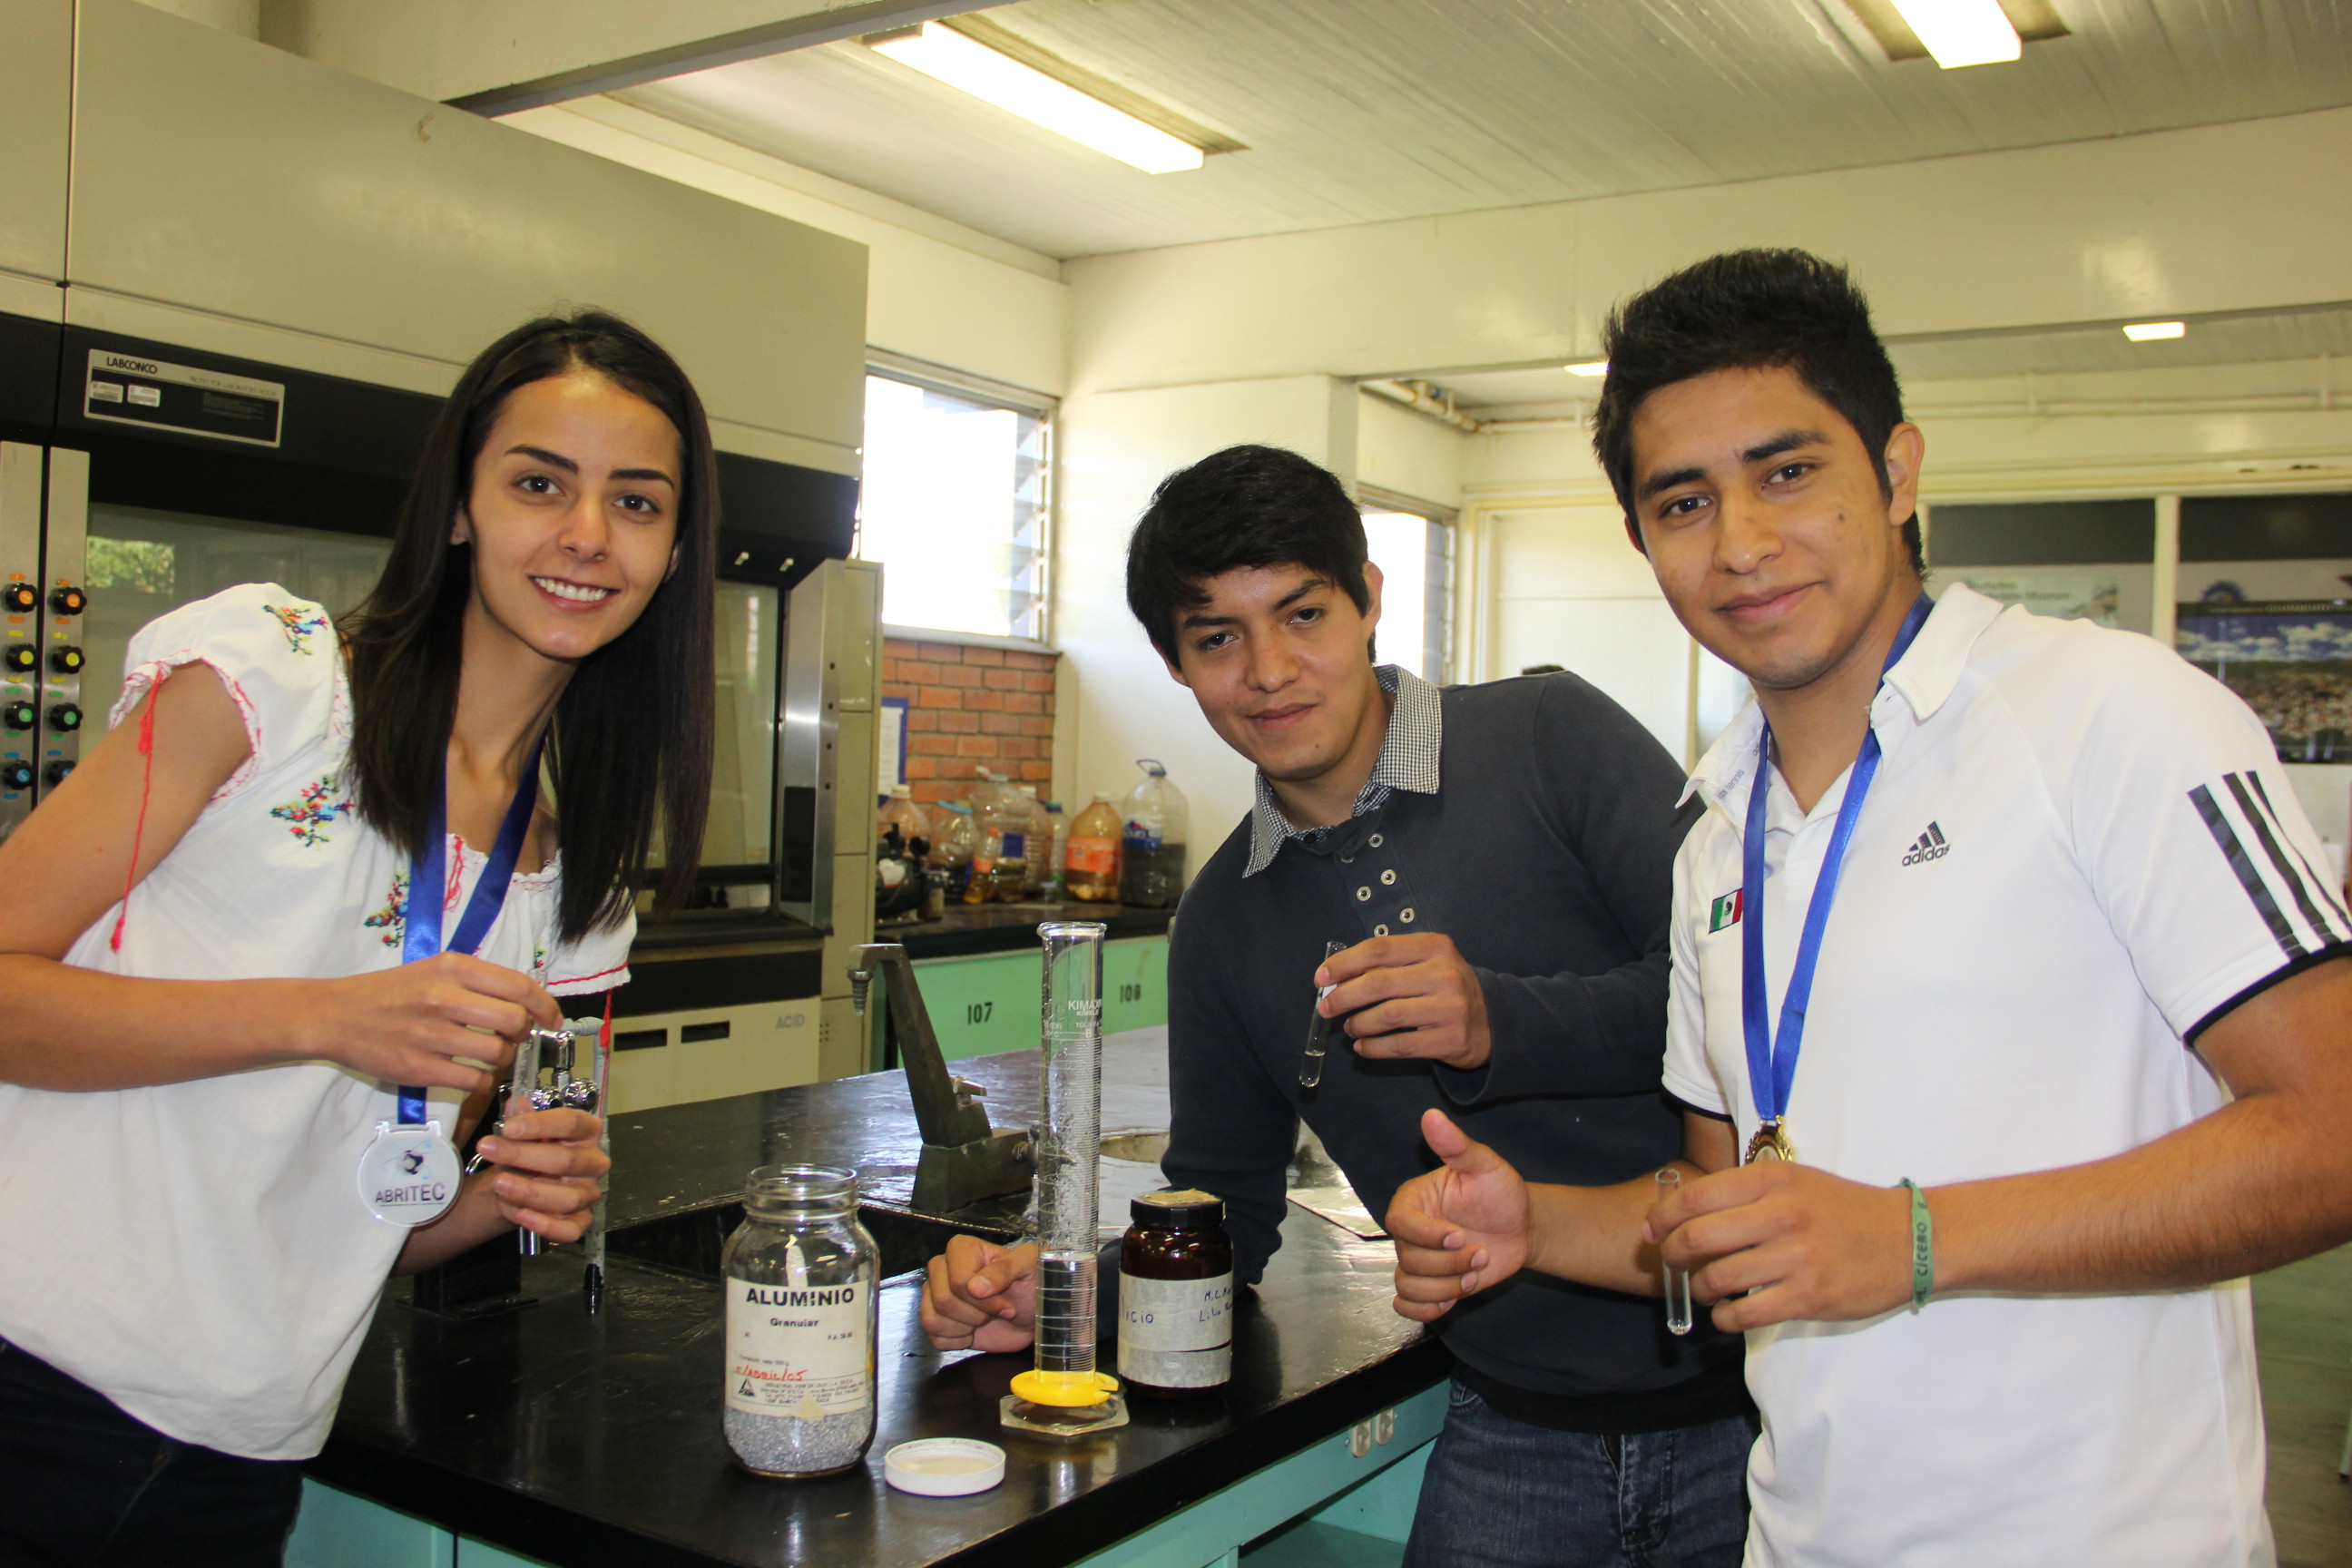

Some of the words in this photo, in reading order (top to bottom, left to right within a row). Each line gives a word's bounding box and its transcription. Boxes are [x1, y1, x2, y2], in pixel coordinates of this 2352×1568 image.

[107, 357, 158, 374] LABCONCO
[1901, 844, 1951, 867] adidas
[1119, 984, 1142, 1003] 108
[967, 1001, 994, 1025] 107
[1068, 1000, 1100, 1011] KIMAX
[776, 1014, 806, 1030] ACID
[375, 1182, 445, 1203] ABRITEC
[1916, 1222, 1928, 1277] CICERO
[746, 1288, 855, 1307] ALUMINIO
[769, 1318, 819, 1328] Granular
